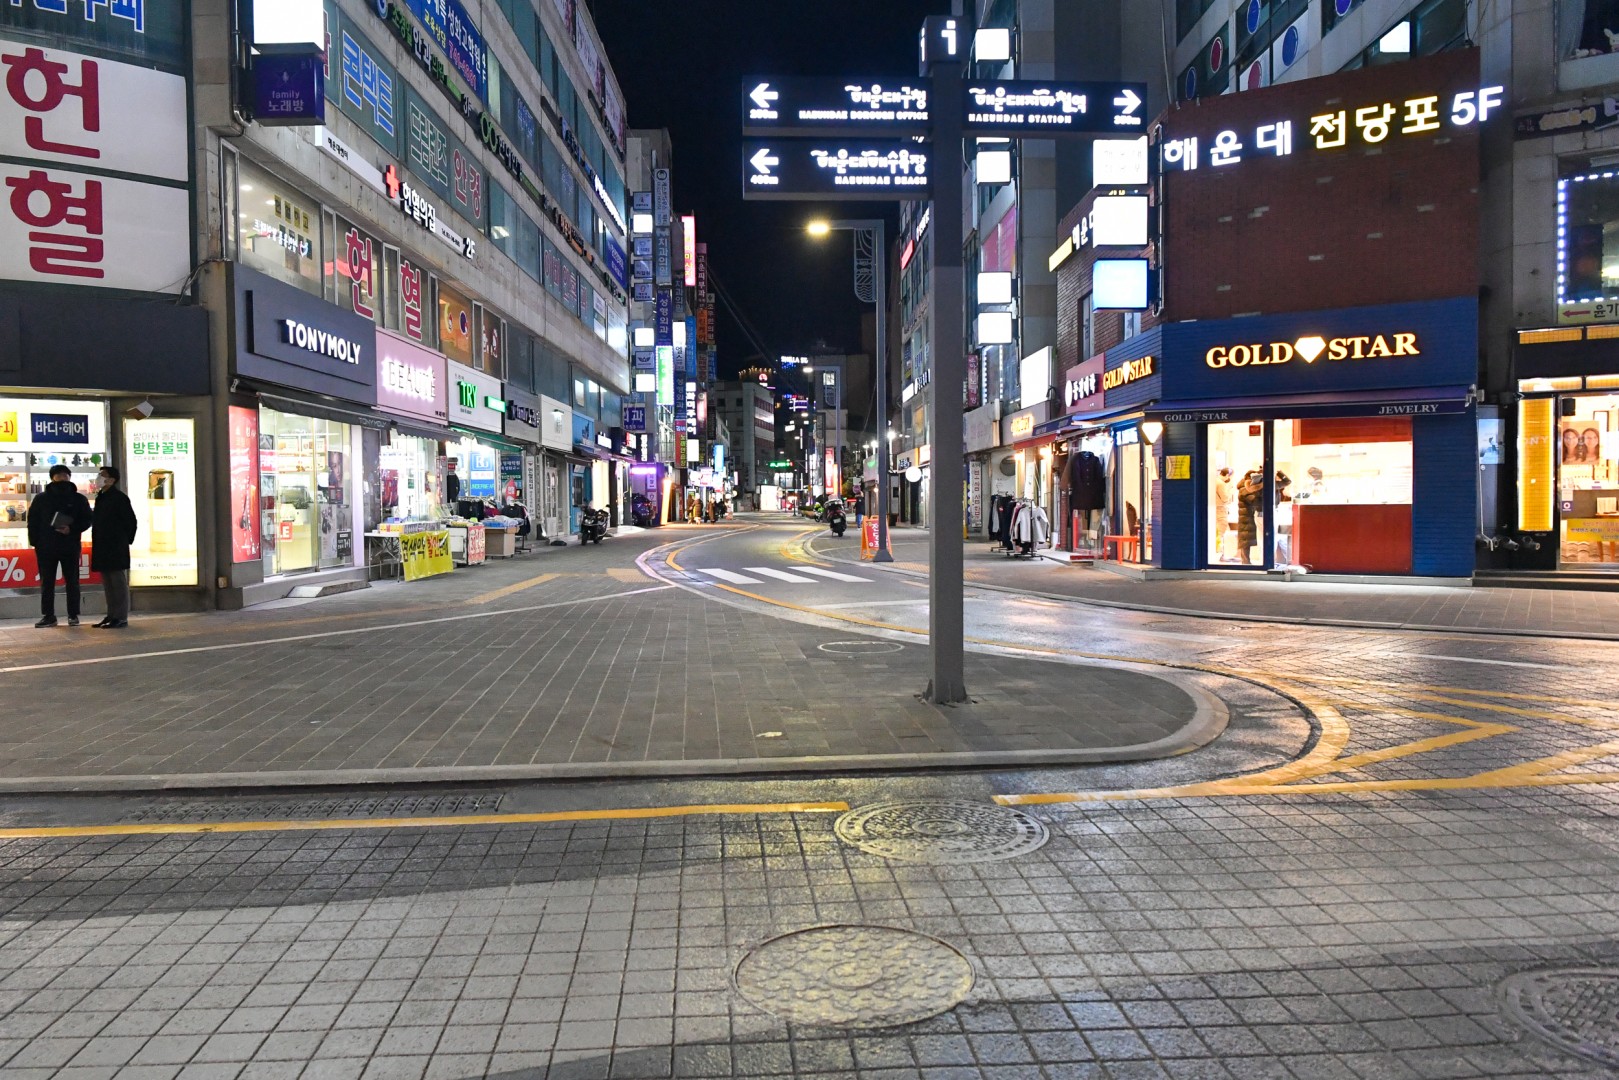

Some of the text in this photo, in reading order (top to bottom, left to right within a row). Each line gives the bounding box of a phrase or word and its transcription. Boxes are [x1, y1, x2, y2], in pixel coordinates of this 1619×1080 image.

[272, 90, 300, 99] family
[343, 30, 394, 137] 콘택트
[844, 84, 927, 111] 해운대구청
[268, 99, 305, 112] 노래방
[968, 86, 1087, 114] 해운대지하철역
[798, 110, 928, 121] HAEUNDAE BOROUGH OFFICE
[968, 113, 1072, 125] HAEUNDAE STATION
[1163, 121, 1293, 172] 해운대
[1309, 94, 1441, 151] 전당포
[1450, 86, 1504, 126] 5F
[2, 47, 104, 279] 헌혈
[810, 148, 926, 174] 해운대해수욕장
[453, 149, 481, 219] 안경
[834, 176, 927, 186] HAEUNDAE BEACH
[401, 181, 436, 233] 헌혈의집
[286, 319, 361, 365] TONYMOLY
[1205, 333, 1420, 368] GOLD STAR
[1103, 371, 1123, 391] GOLD
[1129, 356, 1152, 381] STAR
[460, 380, 478, 408] TRY
[1164, 412, 1229, 422] GOLD STAR
[1378, 404, 1439, 414] JEWELRY
